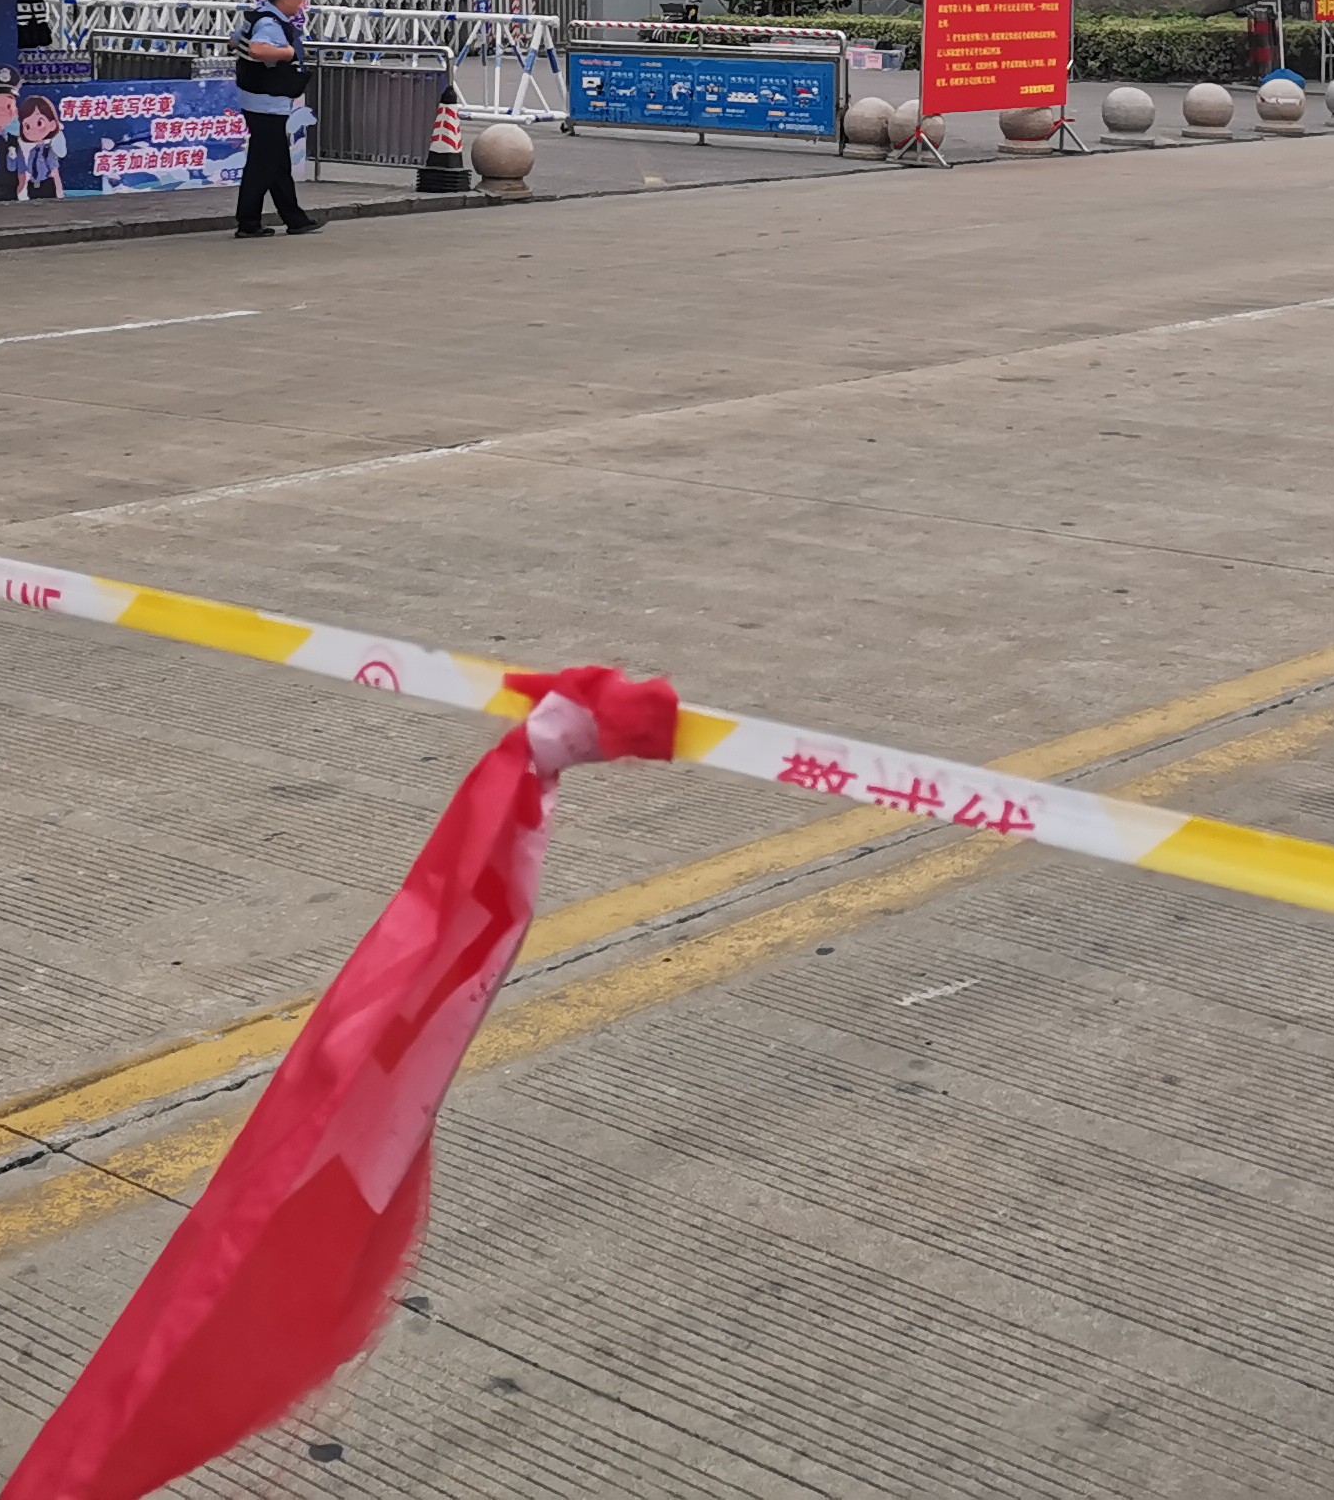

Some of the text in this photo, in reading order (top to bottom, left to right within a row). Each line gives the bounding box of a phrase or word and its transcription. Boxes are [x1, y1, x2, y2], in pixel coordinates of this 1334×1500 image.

[61, 95, 174, 119] 青春执笔写华章
[96, 150, 205, 173] 高考加油创辉煌
